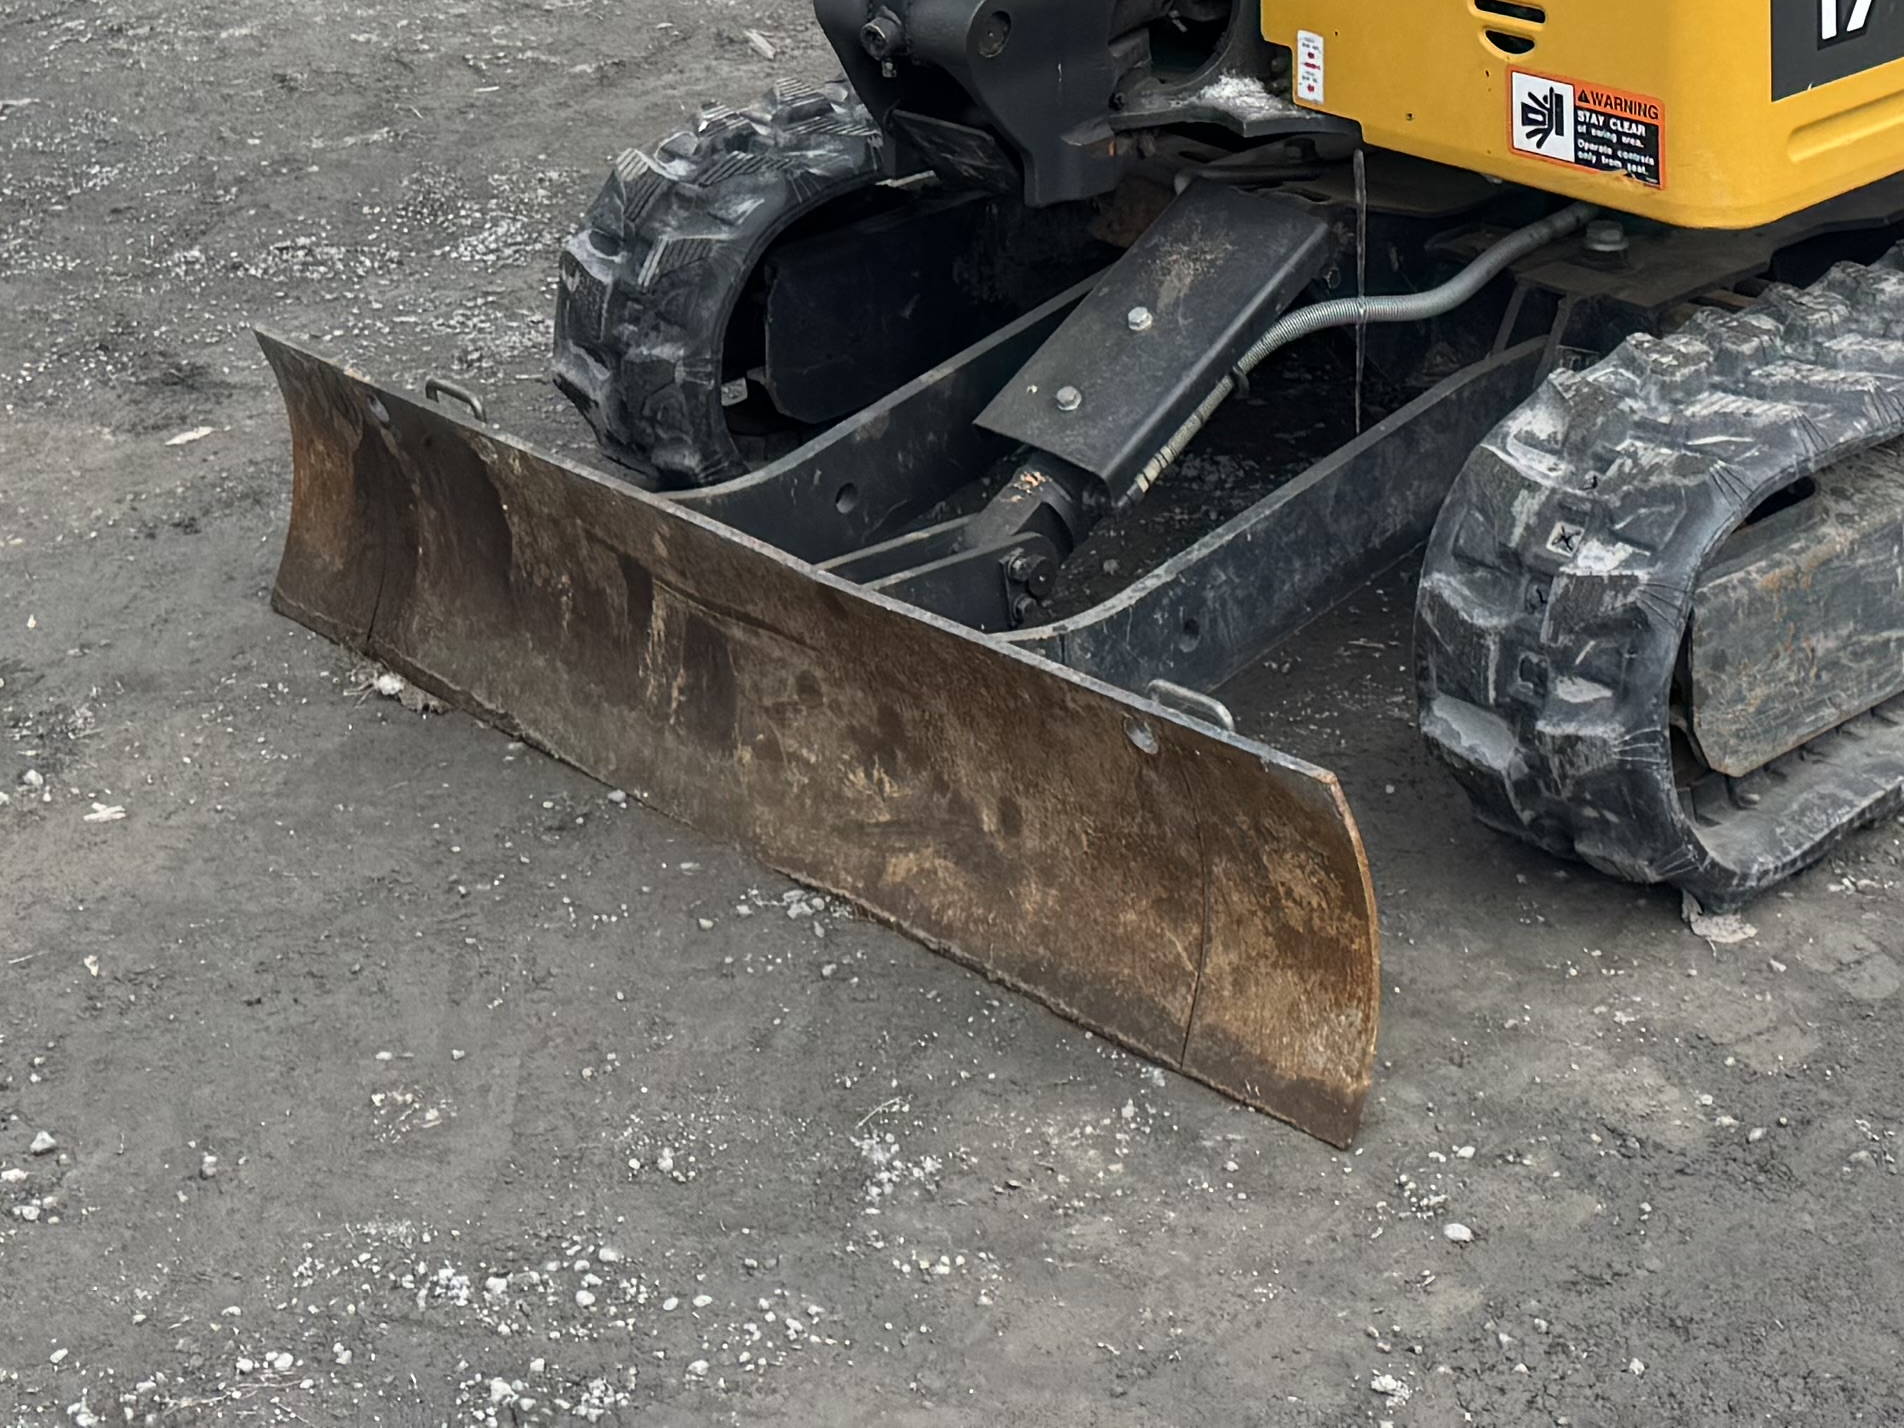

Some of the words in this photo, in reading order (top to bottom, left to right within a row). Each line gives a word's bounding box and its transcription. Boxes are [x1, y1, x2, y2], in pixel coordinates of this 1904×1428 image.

[1590, 90, 1659, 120] WARNING
[1577, 109, 1605, 126] STAY
[1609, 117, 1646, 137] CLEAR
